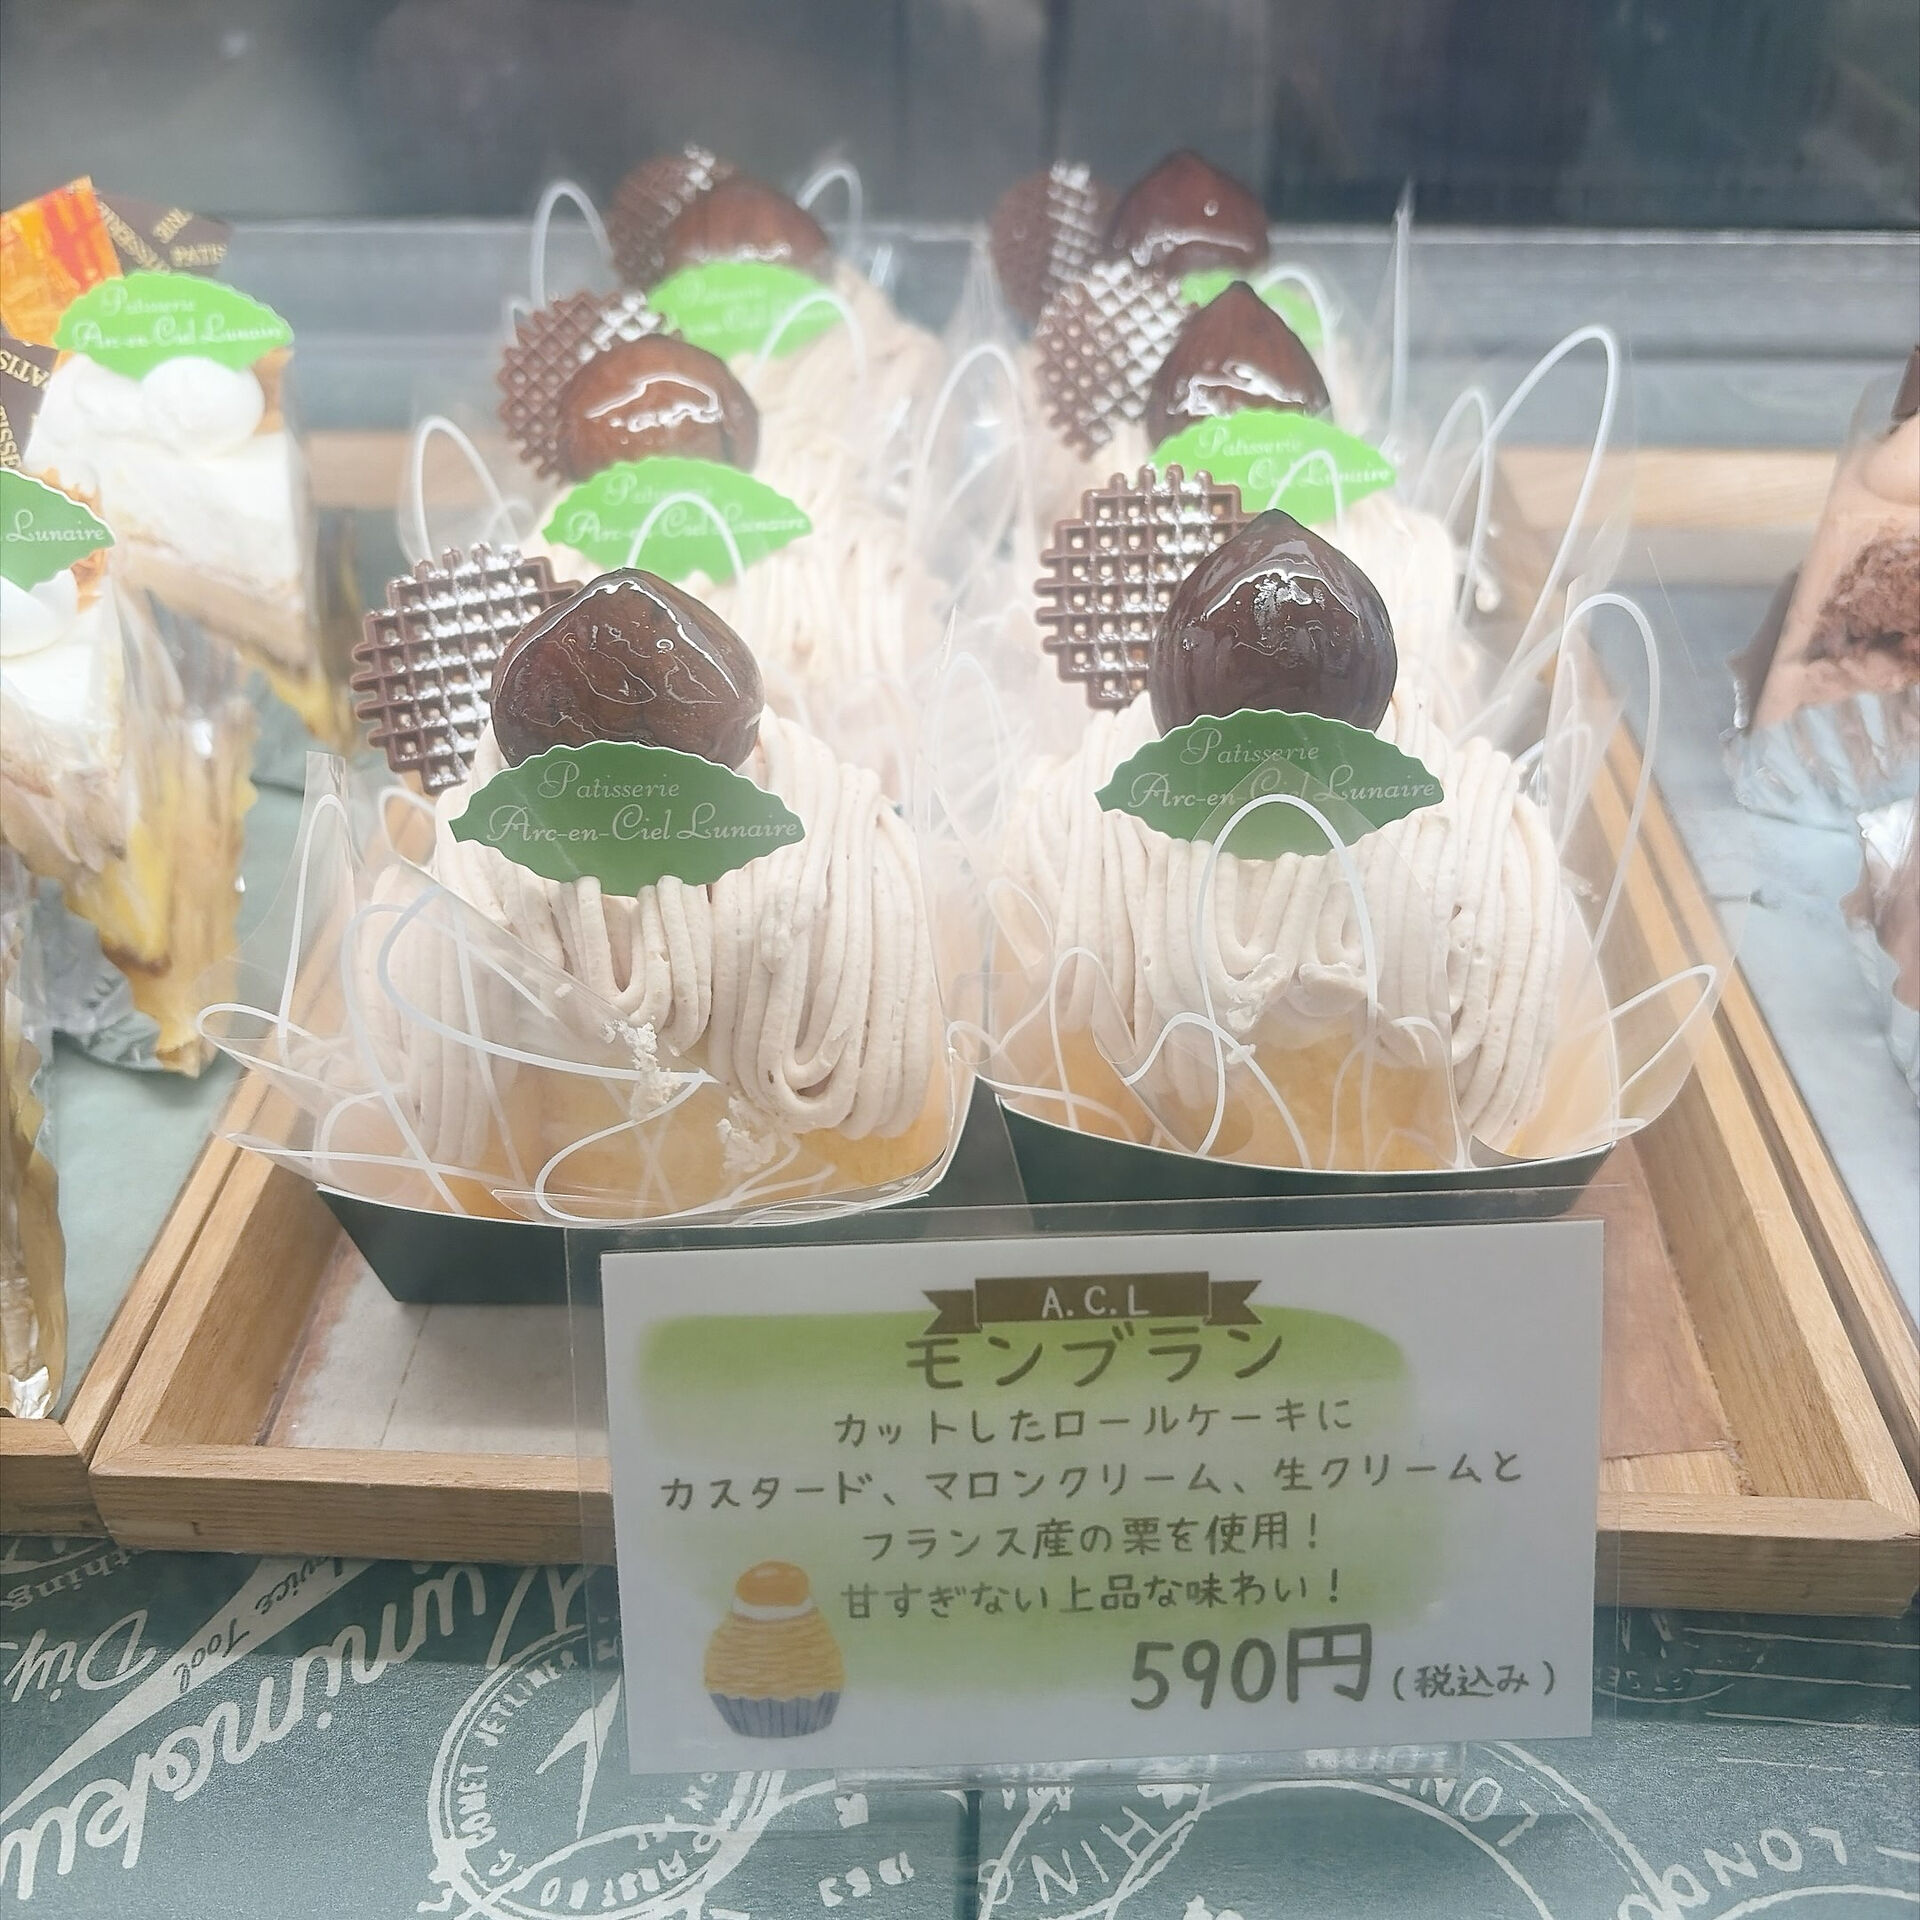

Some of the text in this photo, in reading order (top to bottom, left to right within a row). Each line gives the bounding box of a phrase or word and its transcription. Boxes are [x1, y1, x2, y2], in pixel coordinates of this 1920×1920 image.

[5, 508, 106, 543] Lunaire
[1178, 727, 1319, 765] Patisserie
[536, 760, 680, 799] Patisserie
[1313, 764, 1436, 802] Lunaire
[486, 802, 798, 842] Arc-en-Ciel Lunaire
[1040, 1285, 1151, 1320] A.C.L
[905, 1320, 1283, 1389] モンブラン
[834, 1397, 1352, 1447] カットしたロールケーキに
[660, 1450, 1522, 1511] カスタード、マロンクリーム、生クリームと
[863, 1511, 1318, 1561] フランス産の栗を使用！
[840, 1568, 1338, 1620] 甘すぎない上品な味わい！
[1130, 1623, 1373, 1711] 590円
[1393, 1660, 1555, 1701] （税込み）
